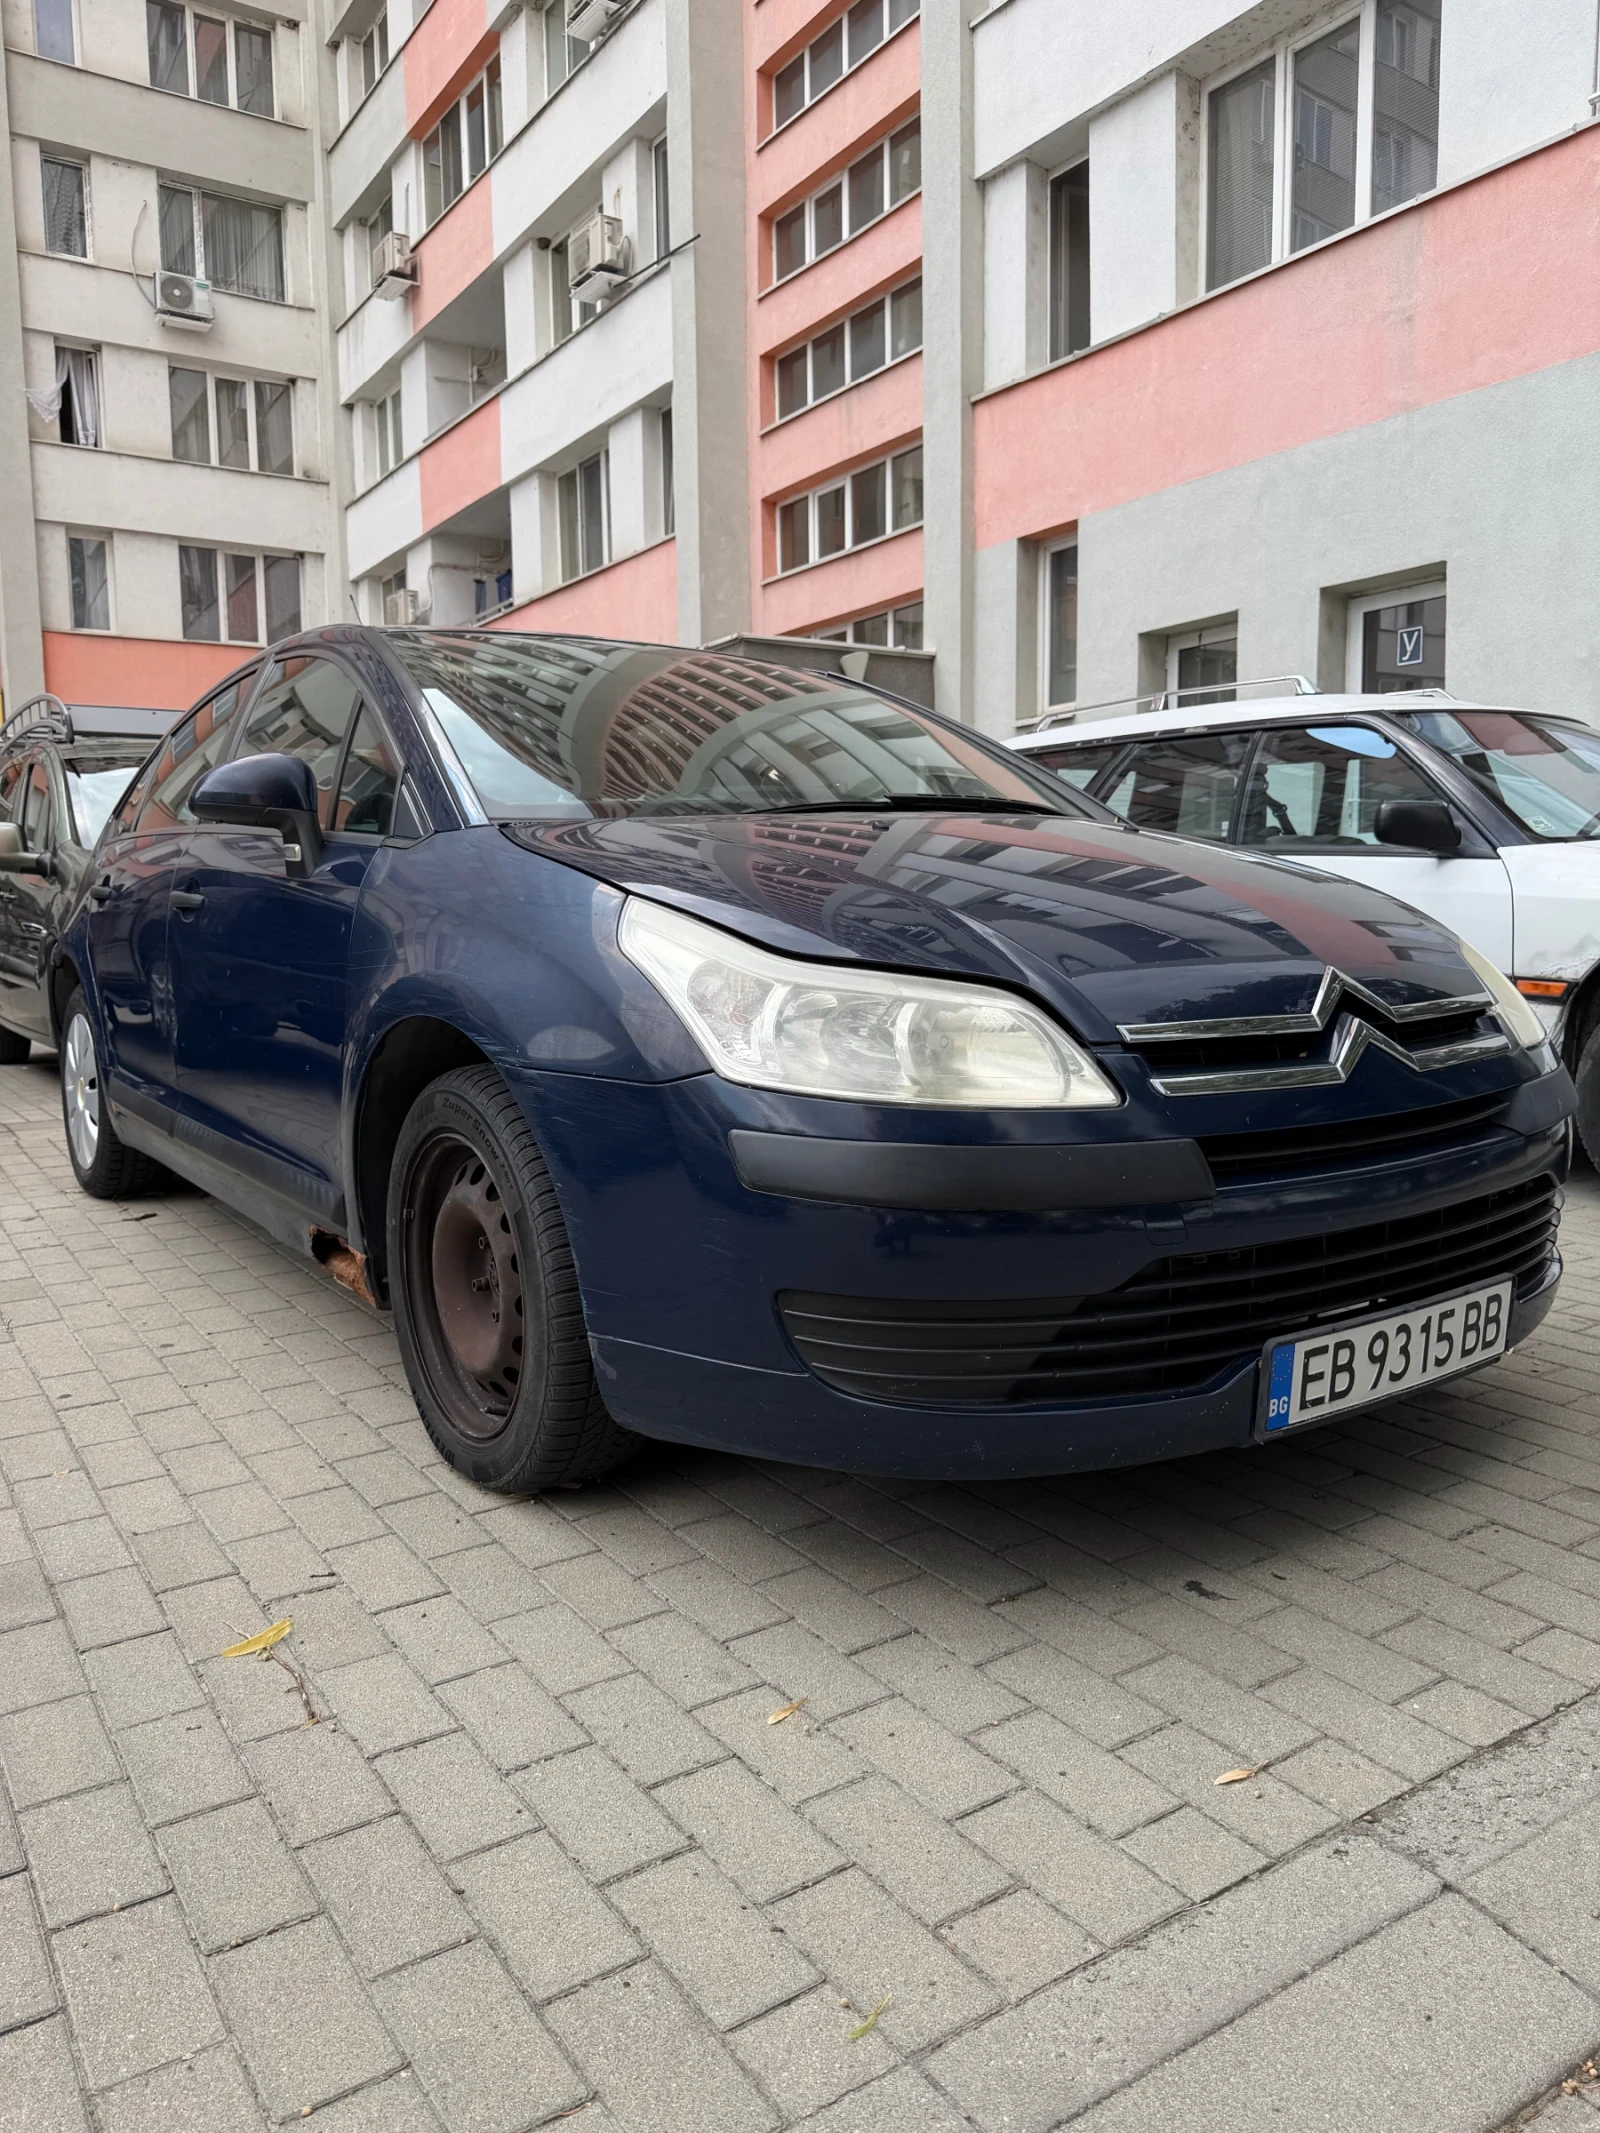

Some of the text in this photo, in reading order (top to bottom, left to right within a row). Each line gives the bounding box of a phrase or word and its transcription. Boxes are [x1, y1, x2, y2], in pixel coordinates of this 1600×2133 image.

[1299, 1293, 1503, 1411] EB 9315 BB
[1269, 1396, 1288, 1417] BG
